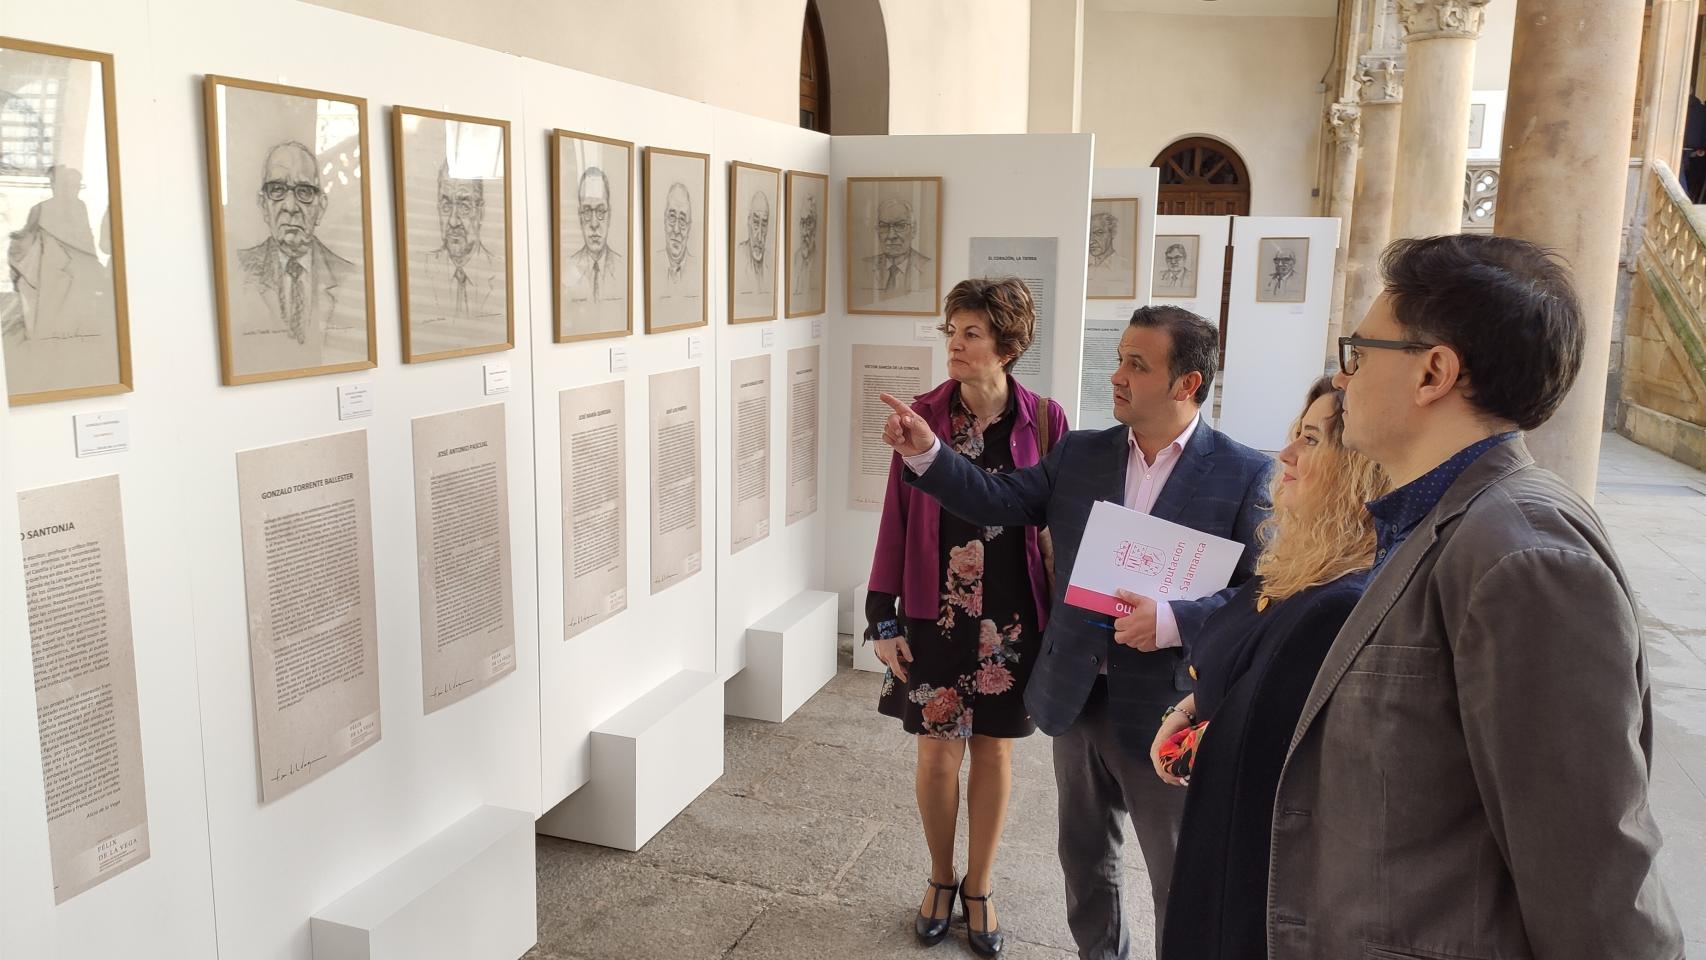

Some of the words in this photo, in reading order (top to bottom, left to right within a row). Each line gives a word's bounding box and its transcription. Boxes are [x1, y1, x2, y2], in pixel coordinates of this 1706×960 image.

[261, 487, 292, 500] GONZALO
[293, 479, 323, 492] TORRENTE
[324, 472, 354, 485] BALLESTER
[27, 522, 75, 540] SANTONJA
[1180, 542, 1206, 592] Salamanca
[98, 853, 108, 861] DE
[119, 839, 137, 850] VEGA
